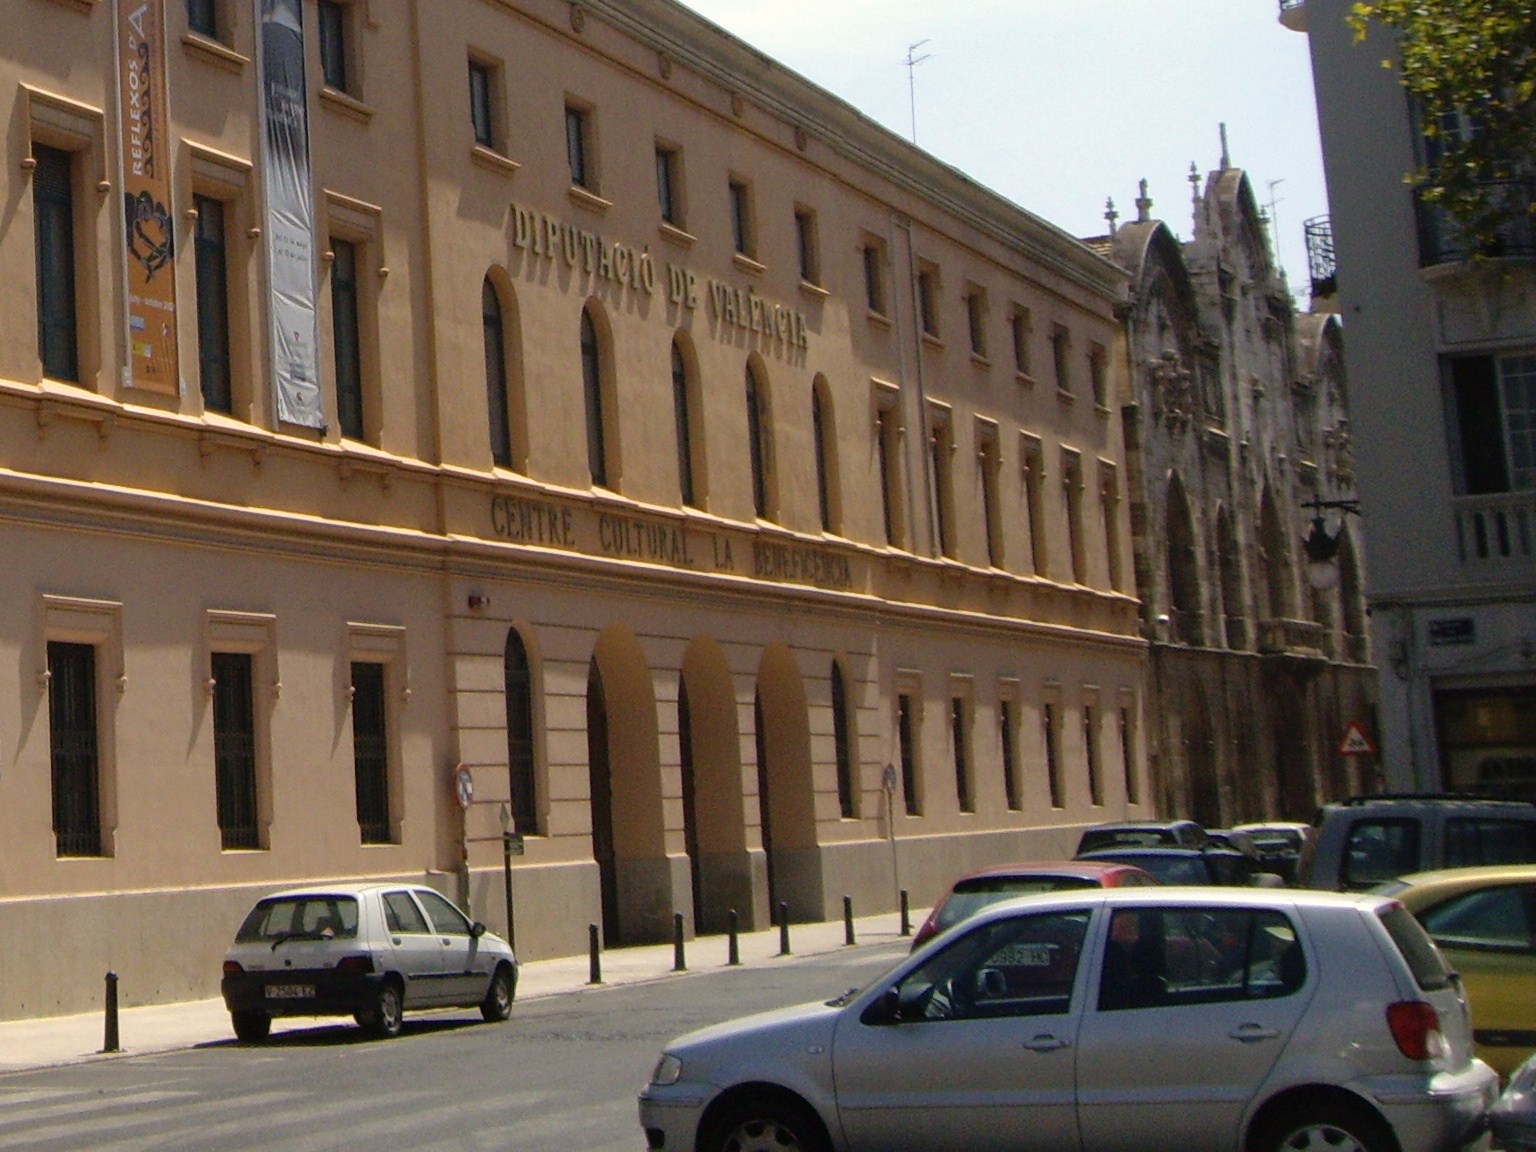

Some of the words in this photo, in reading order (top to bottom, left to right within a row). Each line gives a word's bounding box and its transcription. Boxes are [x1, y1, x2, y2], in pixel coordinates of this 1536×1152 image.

[127, 58, 144, 176] REFLEXOS
[510, 202, 655, 295] DIPUTACIÓ
[667, 262, 697, 309] DE
[491, 497, 575, 547] CENTRE
[599, 512, 694, 564] CULTURAL
[713, 531, 734, 571] LA
